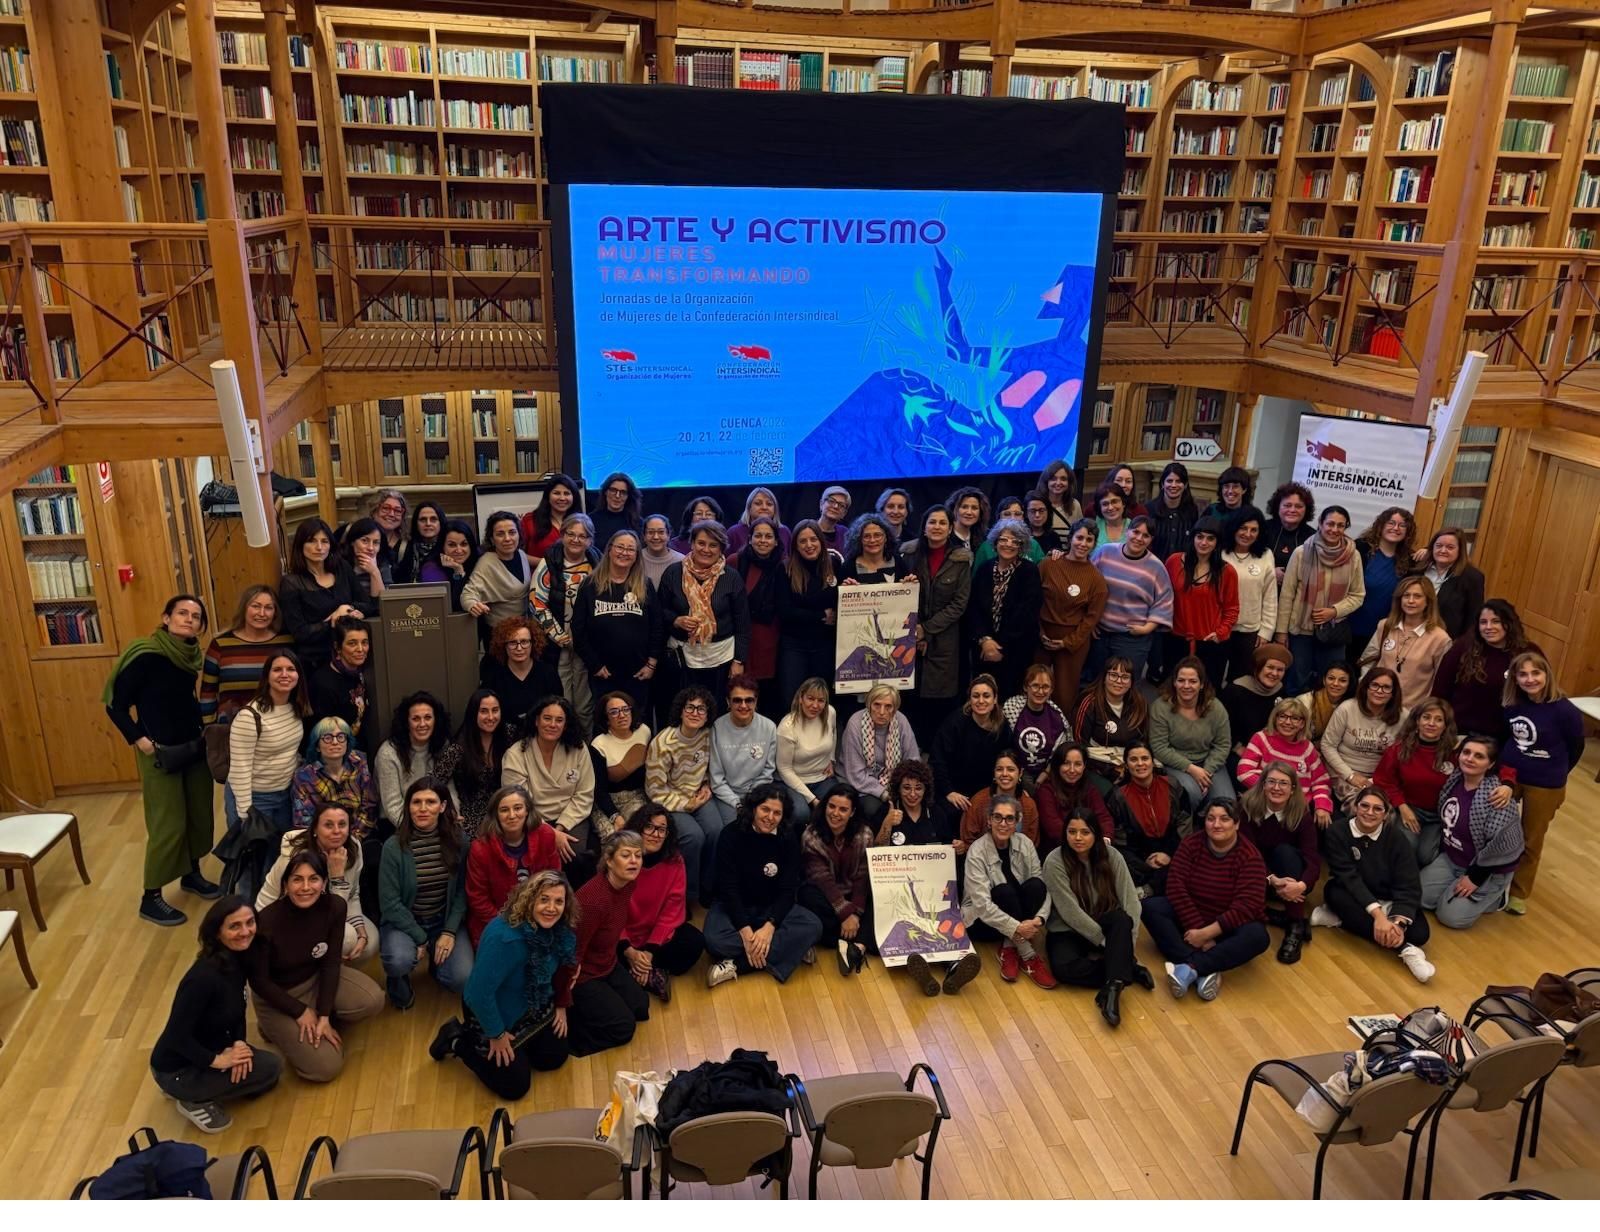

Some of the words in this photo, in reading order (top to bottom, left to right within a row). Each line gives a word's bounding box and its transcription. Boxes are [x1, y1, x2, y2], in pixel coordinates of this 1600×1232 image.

[599, 216, 699, 242] ARTE
[711, 217, 735, 243] Y
[749, 218, 946, 244] ACTIVISMO
[599, 246, 716, 263] MUJERES
[599, 267, 811, 284] TRANSFORMANDO
[600, 292, 651, 304] Jornadas
[655, 293, 667, 304] de
[671, 292, 681, 304] la
[684, 292, 754, 306] Organización
[600, 310, 614, 322] de
[617, 311, 661, 324] Mujeres
[665, 310, 678, 322] de
[681, 310, 691, 322] la
[694, 310, 771, 322] Confederación
[773, 309, 839, 321] Intersindical
[717, 367, 780, 375] INTERSINDICAL
[719, 431, 732, 441] 22
[1194, 445, 1215, 456] WC
[1309, 462, 1408, 481] CONFEDERACIÓN
[1307, 467, 1405, 491] INTERSINDICAL
[1306, 479, 1354, 492] Organización
[1357, 485, 1367, 493] de
[1371, 487, 1403, 499] Mujeres
[870, 589, 911, 597] ACTIVISMO
[595, 600, 641, 612] SUBVERSIVES
[390, 617, 440, 627] SEMINARIO
[872, 854, 891, 862] ARTE
[902, 853, 947, 861] ACTIVISMO
